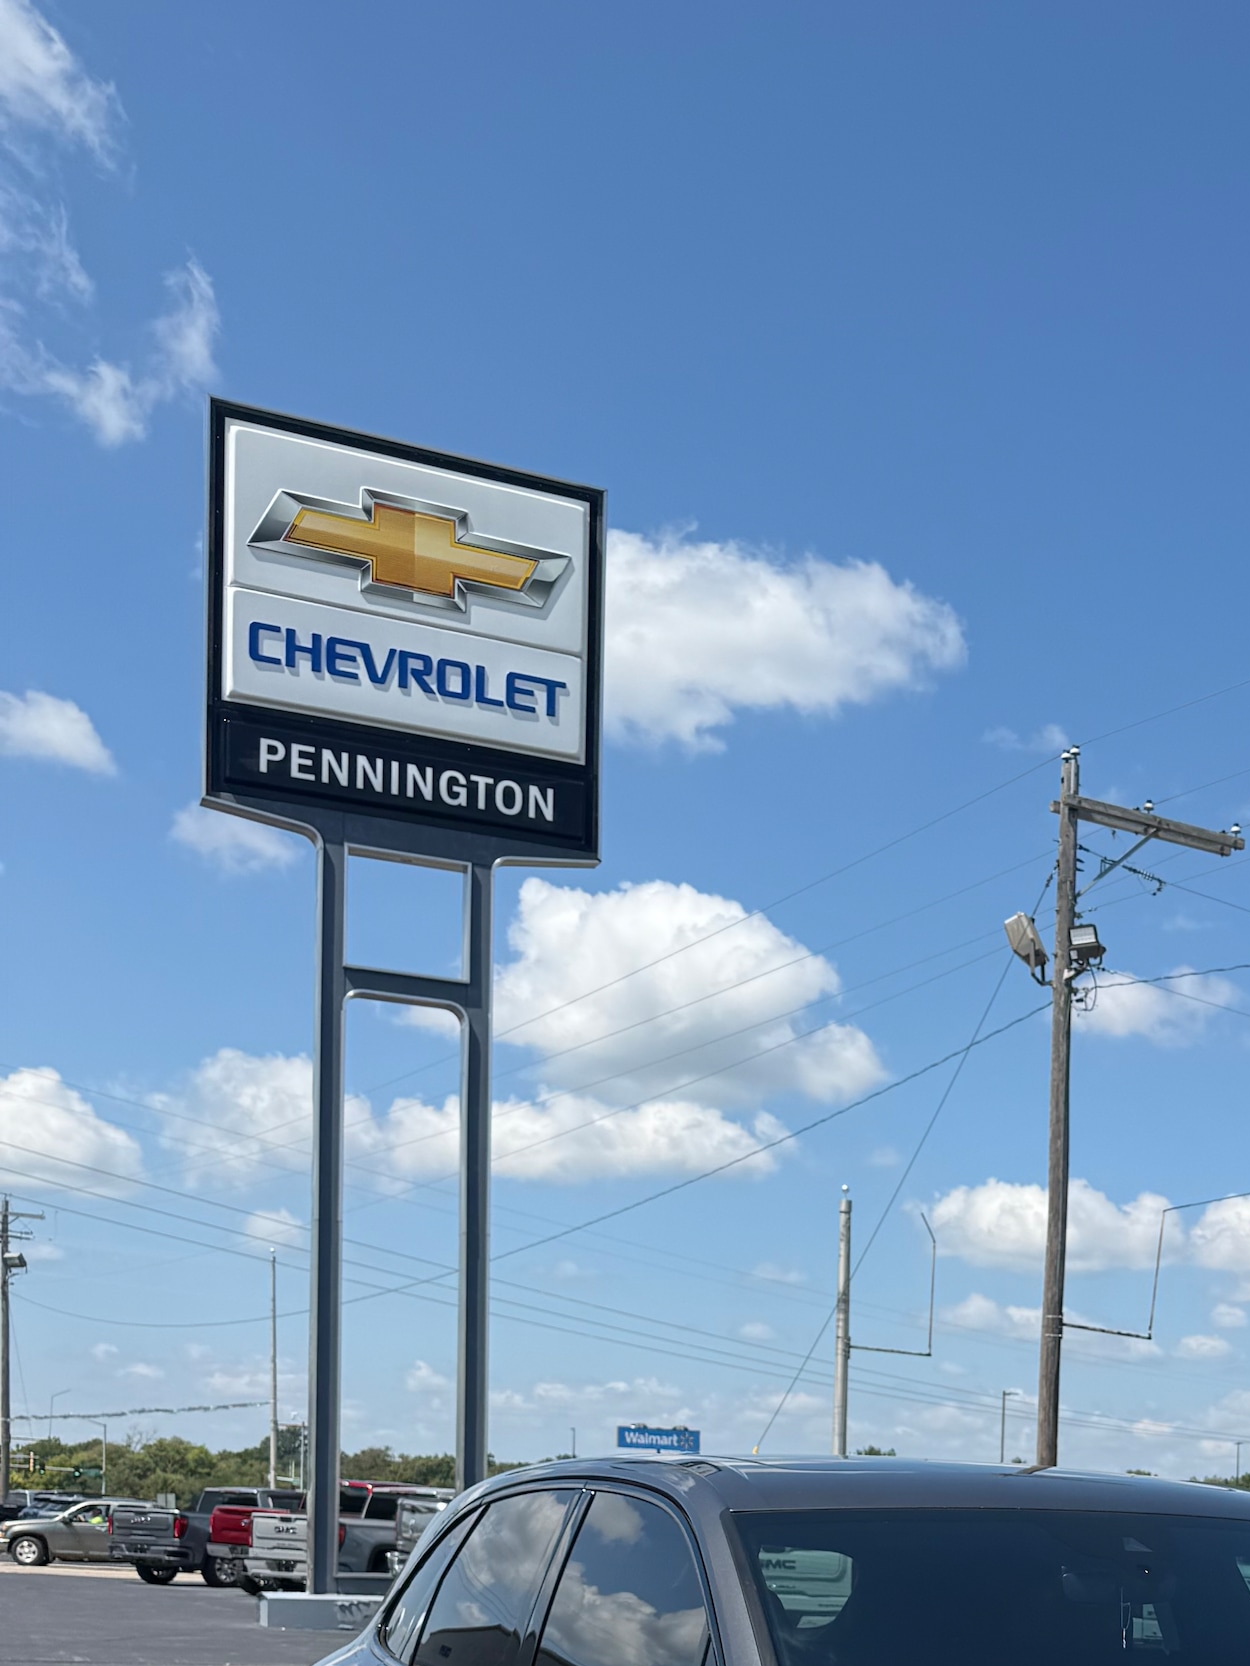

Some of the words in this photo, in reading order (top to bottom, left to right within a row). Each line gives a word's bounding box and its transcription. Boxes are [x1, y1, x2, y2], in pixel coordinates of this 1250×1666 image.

[248, 621, 567, 717] CHEVROLET
[259, 737, 555, 822] PENNINGTON
[624, 1431, 678, 1447] Walmart
